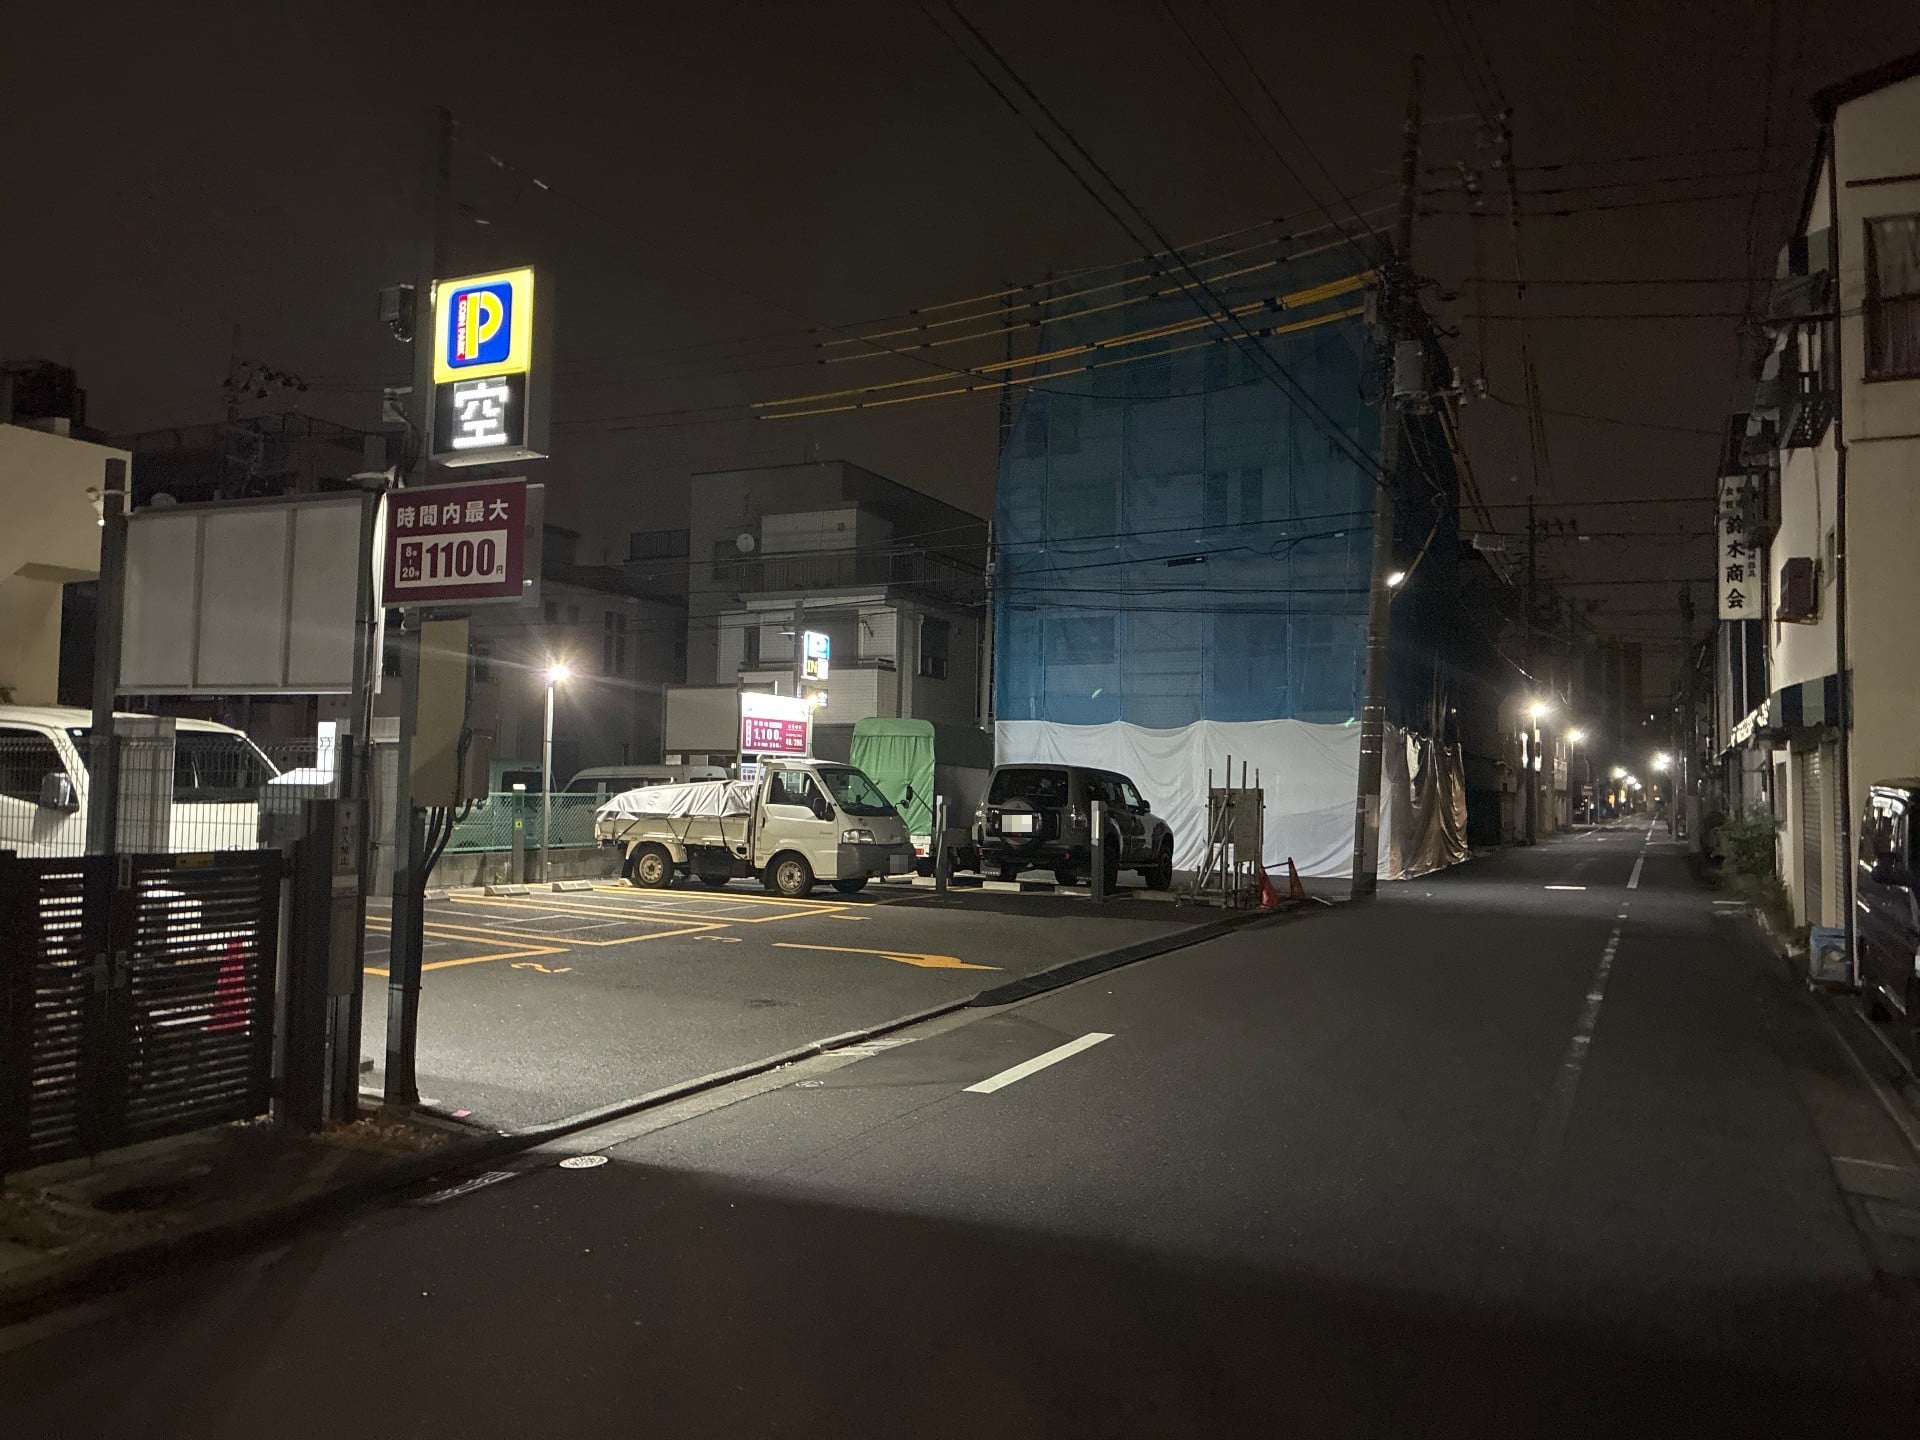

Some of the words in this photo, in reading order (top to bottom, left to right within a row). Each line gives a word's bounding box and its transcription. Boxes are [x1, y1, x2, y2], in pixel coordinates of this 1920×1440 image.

[452, 382, 511, 450] 空
[396, 498, 509, 529] 時間内最大
